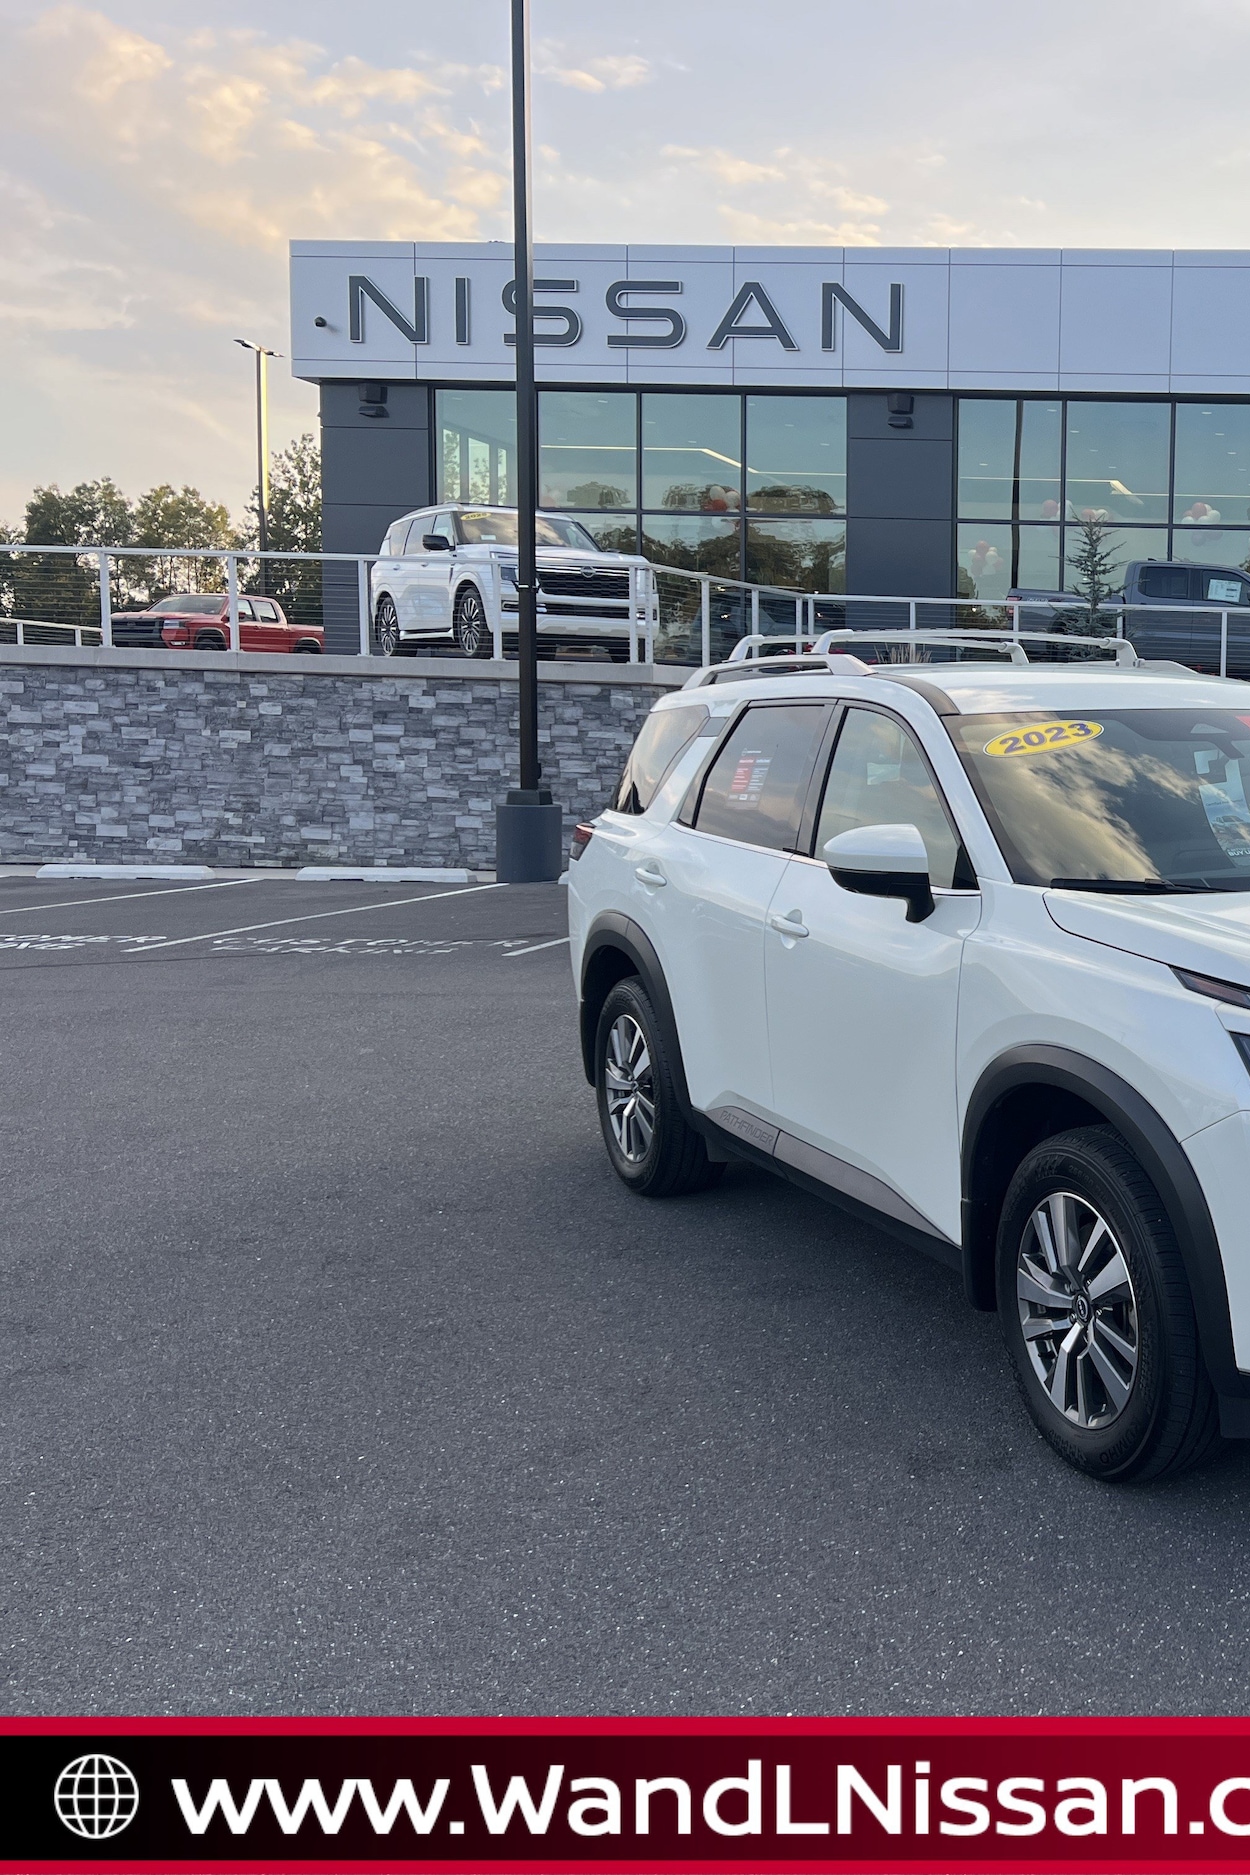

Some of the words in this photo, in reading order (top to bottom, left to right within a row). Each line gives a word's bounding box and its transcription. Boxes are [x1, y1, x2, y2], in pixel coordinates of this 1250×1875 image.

[348, 274, 904, 353] NISSAN
[1000, 723, 1093, 755] 2023
[720, 1110, 775, 1146] PATHFINDER
